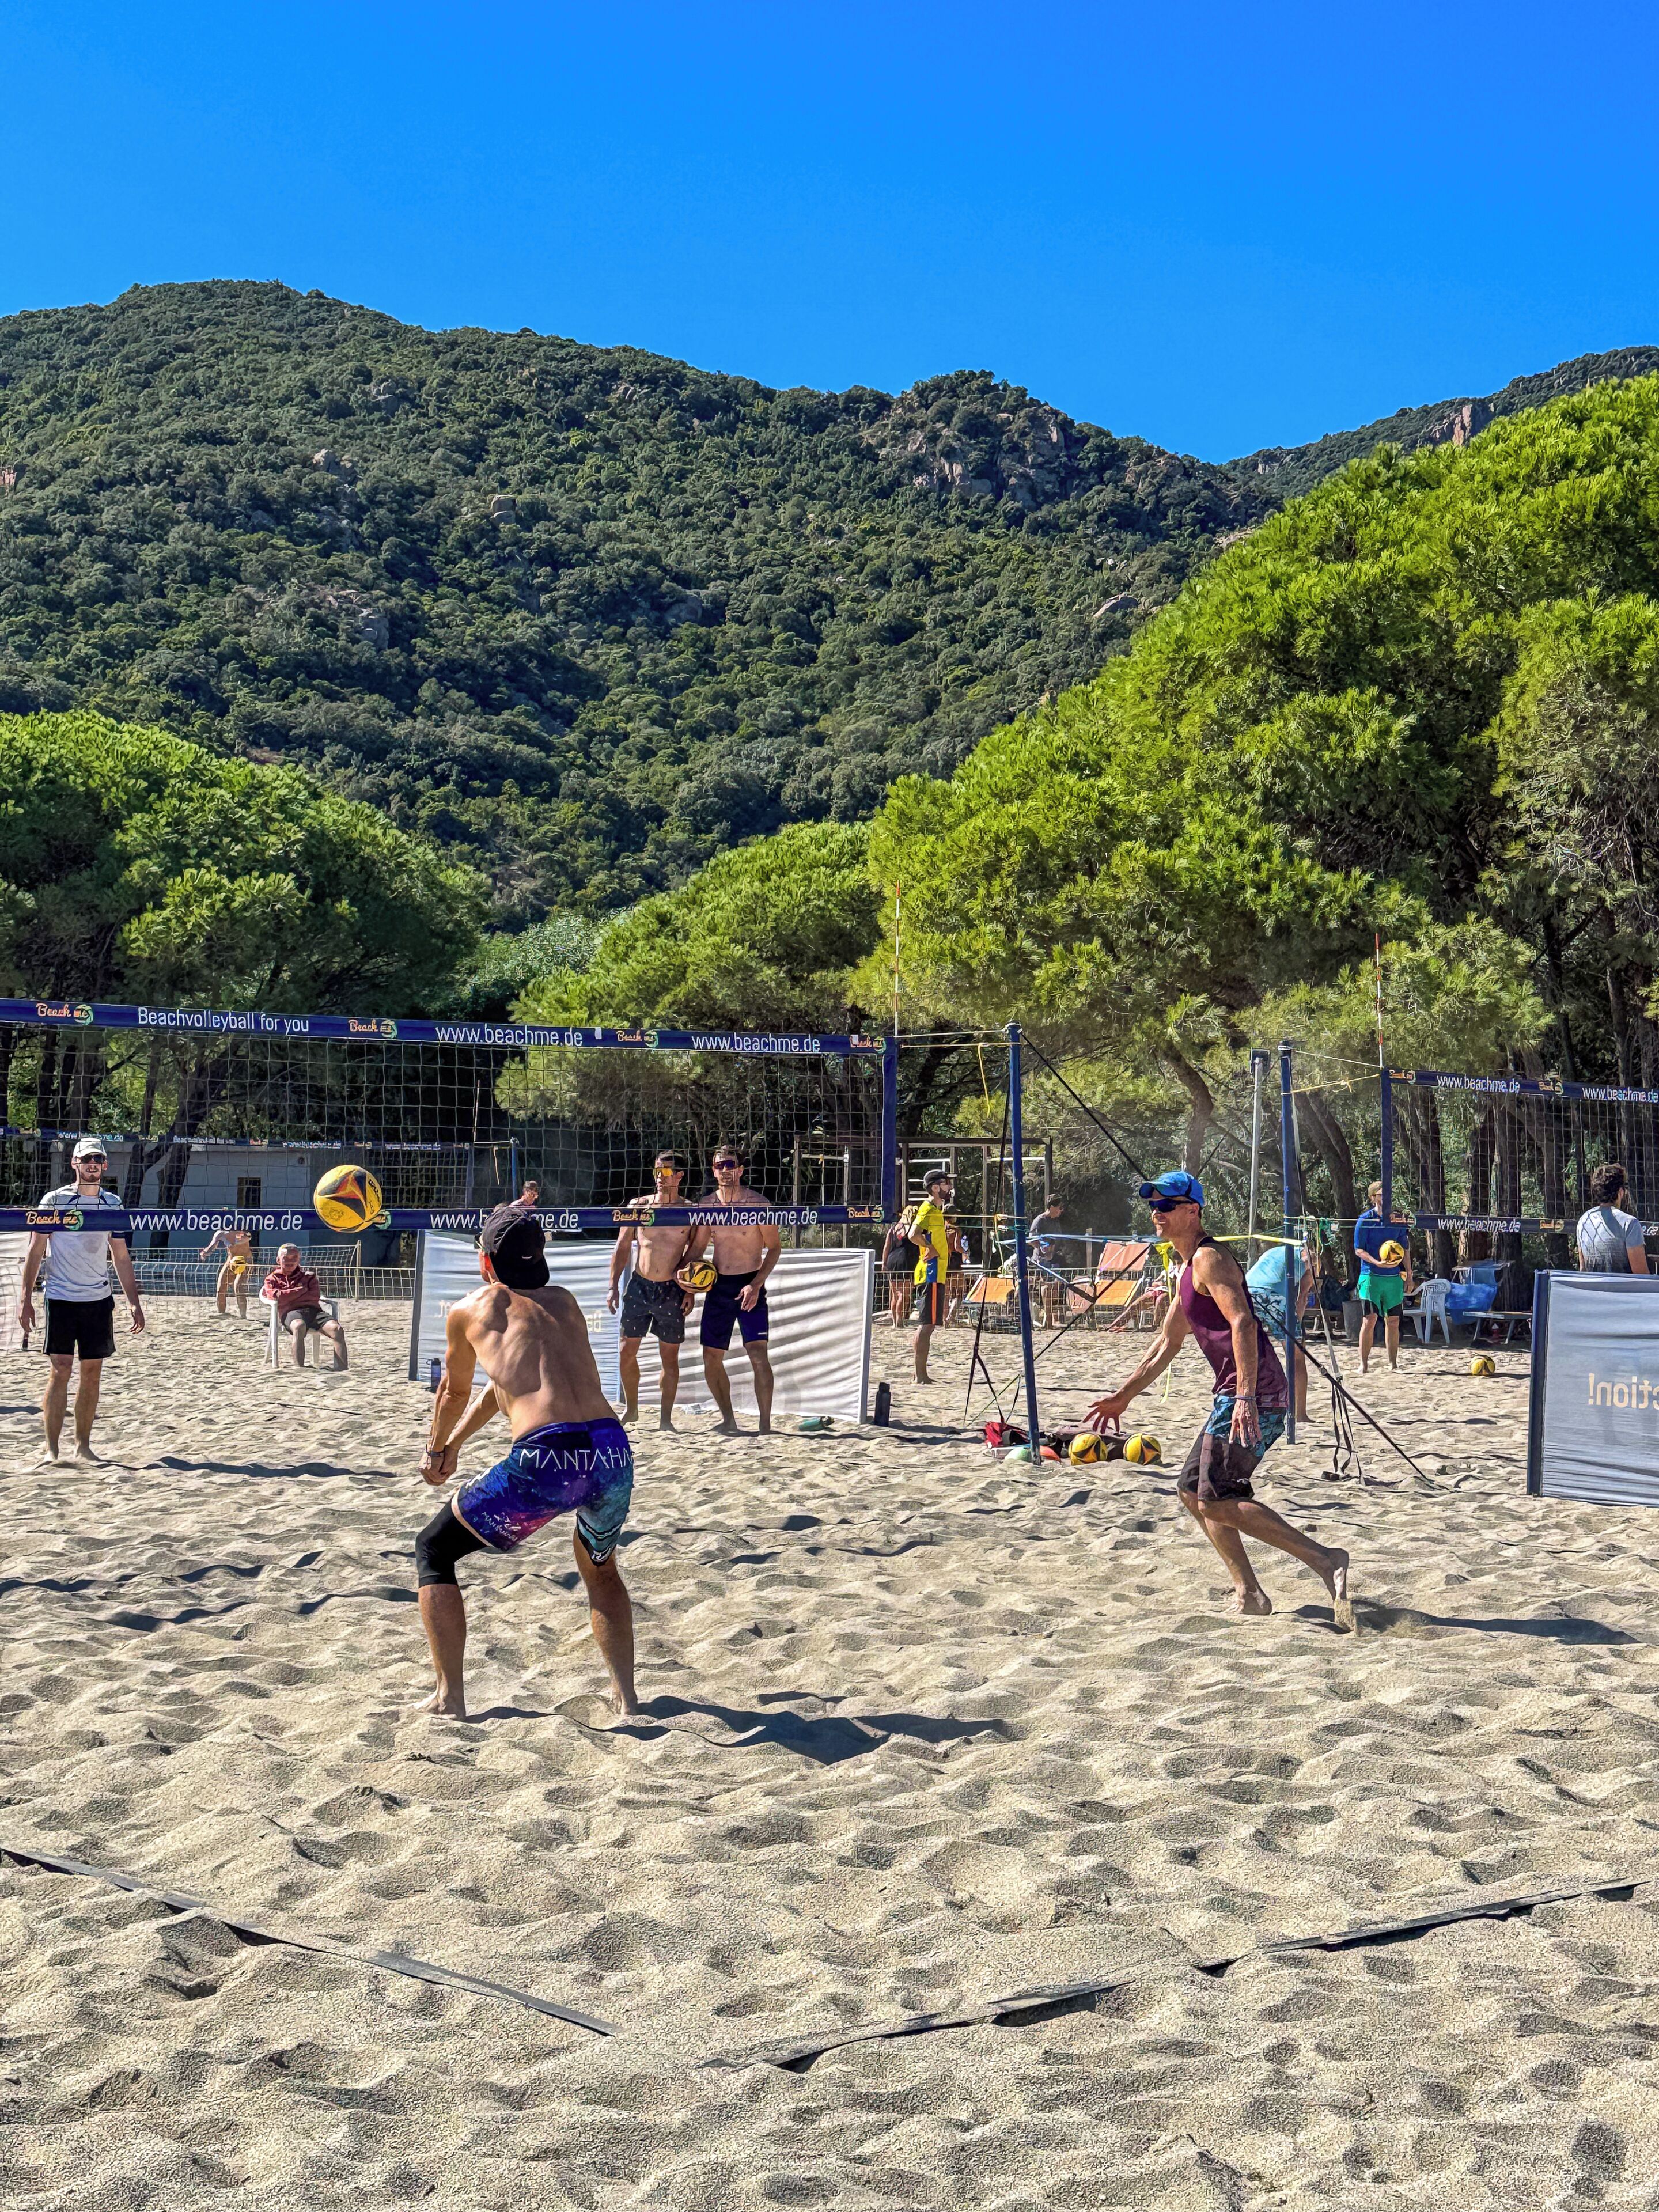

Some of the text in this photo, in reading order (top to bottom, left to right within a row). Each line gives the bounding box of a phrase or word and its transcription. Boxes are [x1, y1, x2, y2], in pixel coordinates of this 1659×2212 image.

[36, 1003, 71, 1017] Beach
[138, 1007, 309, 1035] Beachvolleyball for you
[435, 1023, 583, 1047] www.beachme.de
[691, 1032, 820, 1052] www.beachme.de
[1437, 1073, 1520, 1093] www.beachme.de
[1582, 1085, 1659, 1103] www.beachme.de
[25, 1209, 60, 1224] Beach
[129, 1209, 303, 1230] www.beachme.de
[688, 1207, 818, 1226] www.beachme.de
[1438, 1216, 1521, 1233] www.beachme.de
